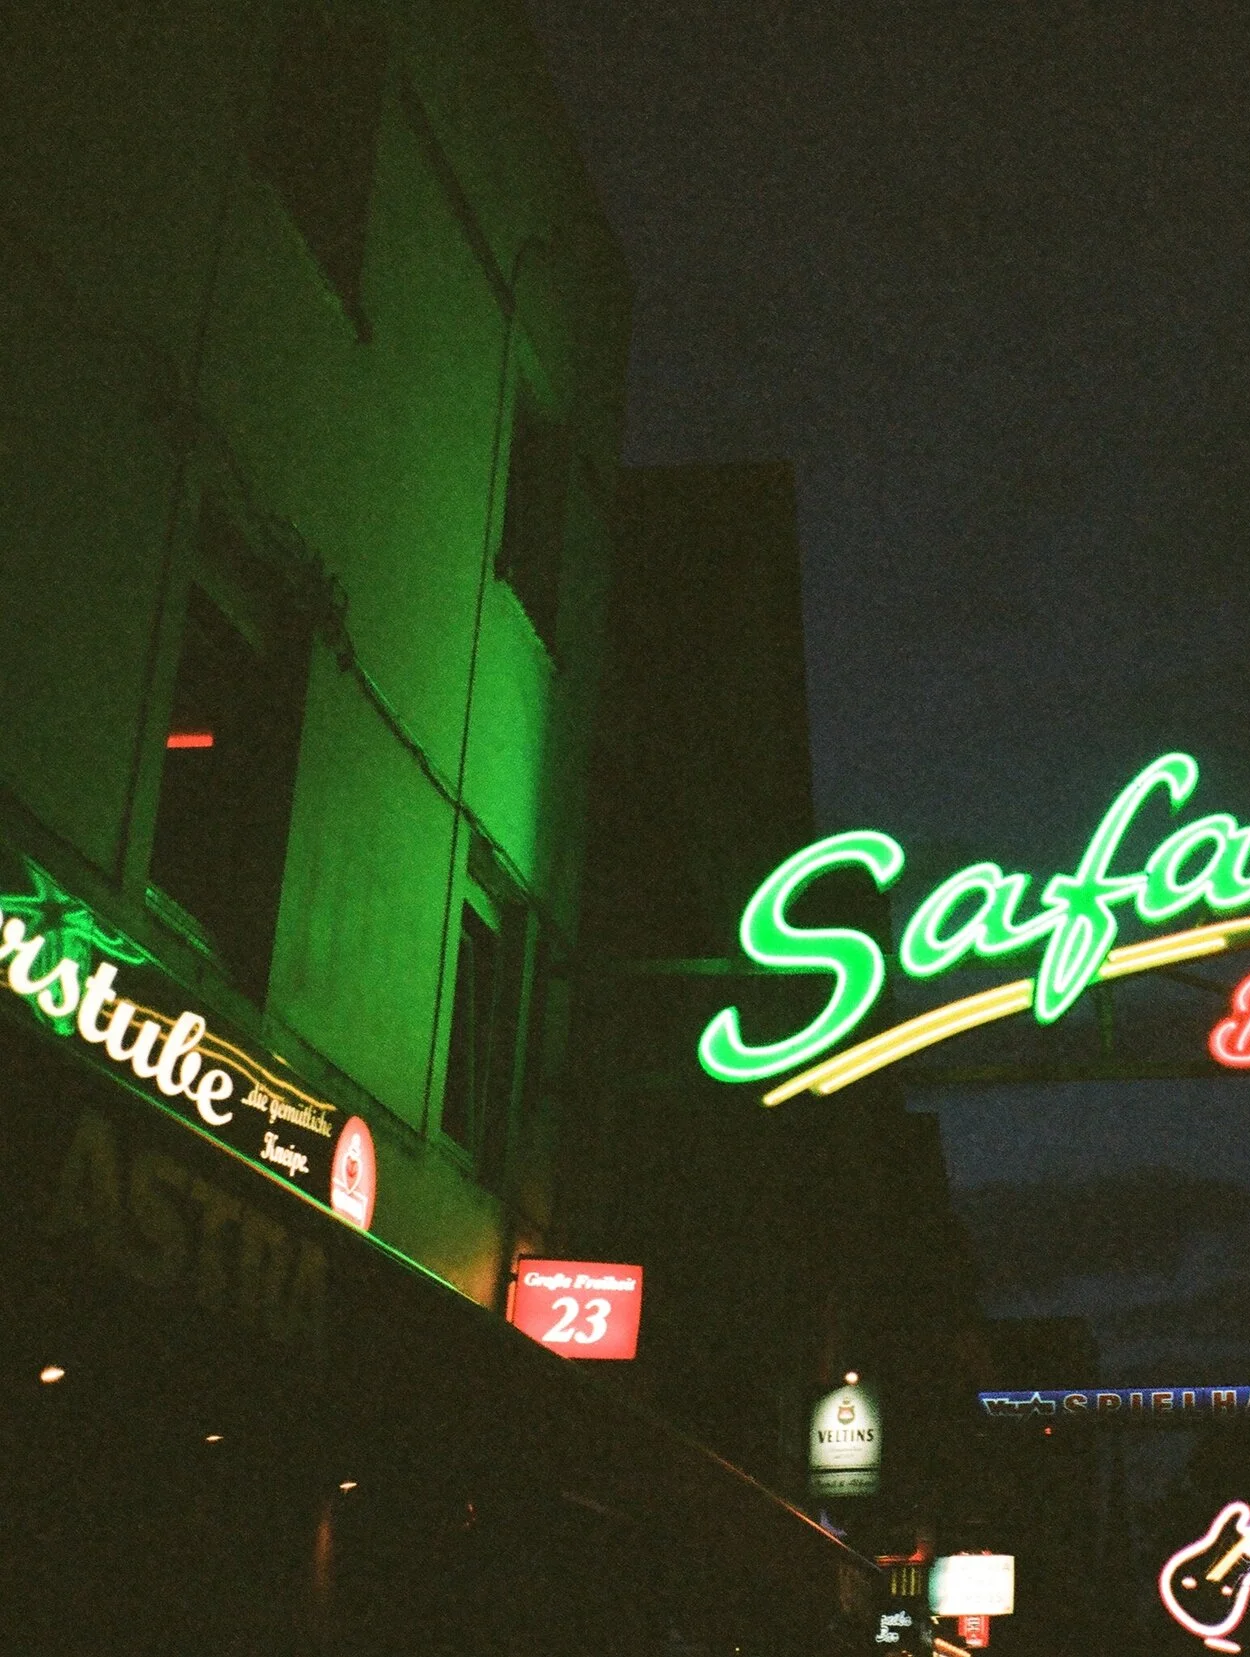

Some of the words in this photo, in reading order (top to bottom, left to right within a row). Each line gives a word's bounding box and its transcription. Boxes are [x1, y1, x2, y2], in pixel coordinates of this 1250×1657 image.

[0, 907, 233, 1125] rstube
[541, 1296, 611, 1344] 23
[818, 1428, 875, 1444] VELTINS
